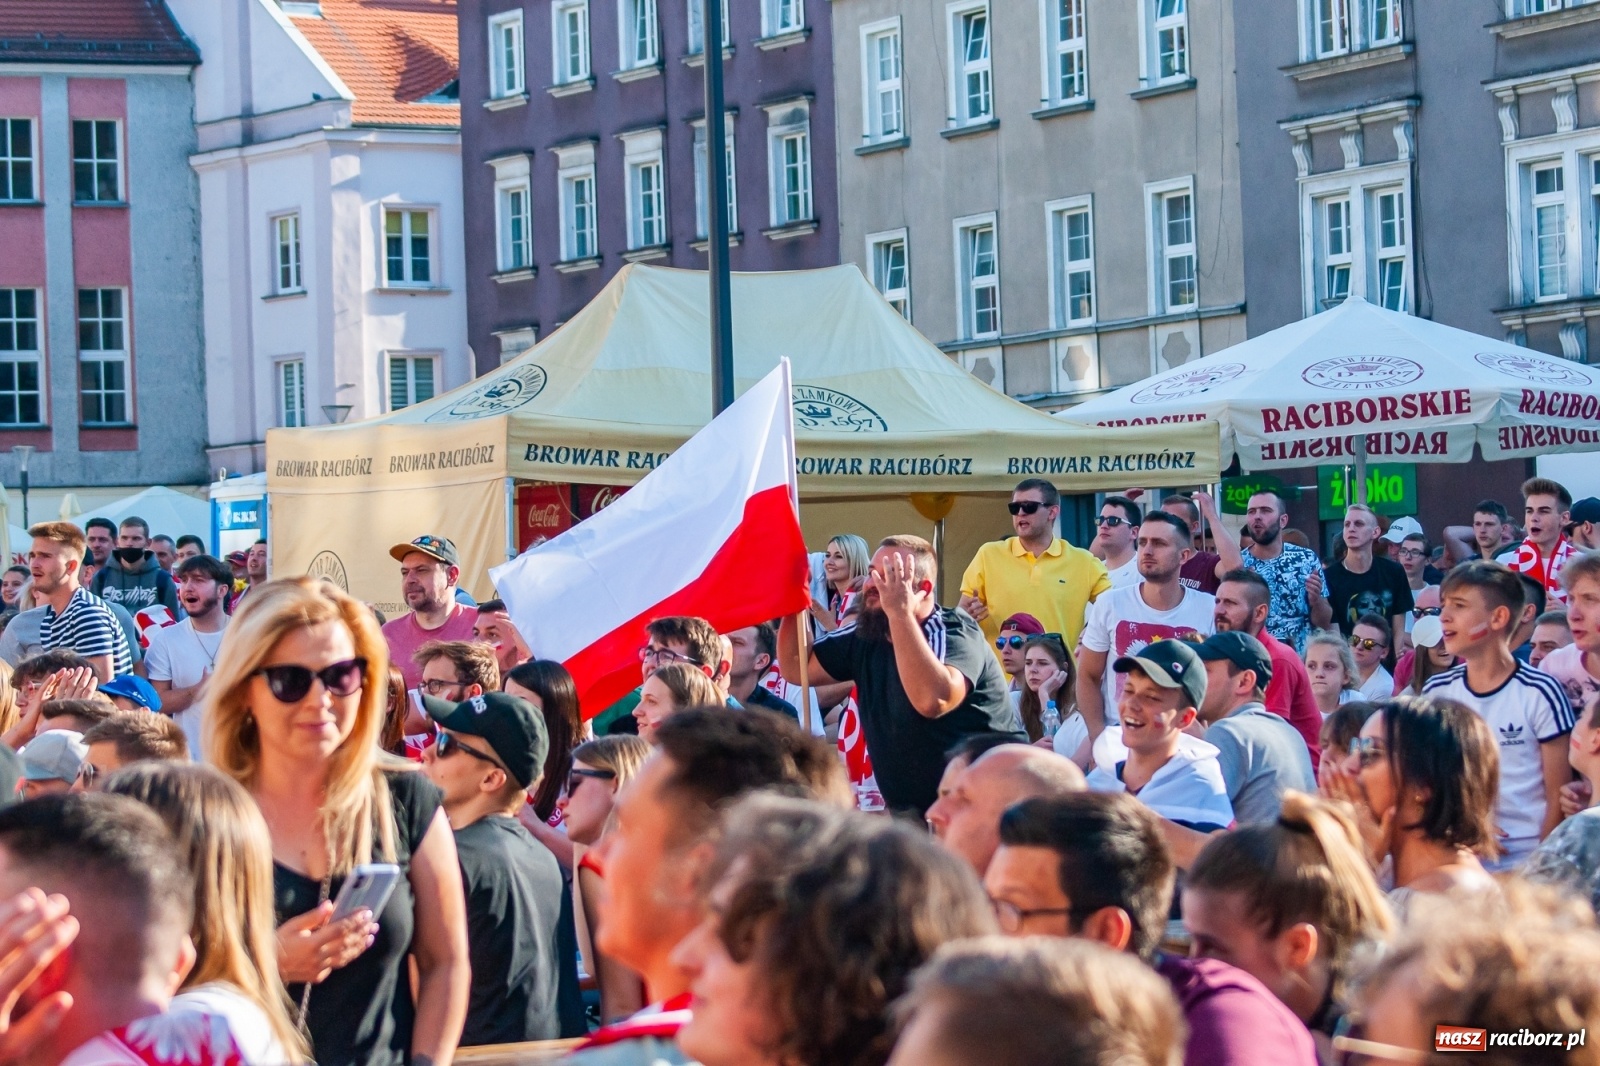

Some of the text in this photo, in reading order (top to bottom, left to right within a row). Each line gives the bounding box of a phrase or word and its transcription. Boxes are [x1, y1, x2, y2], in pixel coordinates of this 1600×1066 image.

[1261, 388, 1472, 434] RACIBORSKIE
[276, 454, 373, 478] BROWAR RACIBÓRZ
[389, 442, 495, 474] BROWAR RACIBÓRZ
[524, 443, 621, 468] BROWAR
[869, 454, 973, 476] RACIBÓRZ
[1007, 449, 1196, 475] BROWAR RACIBÓRZ
